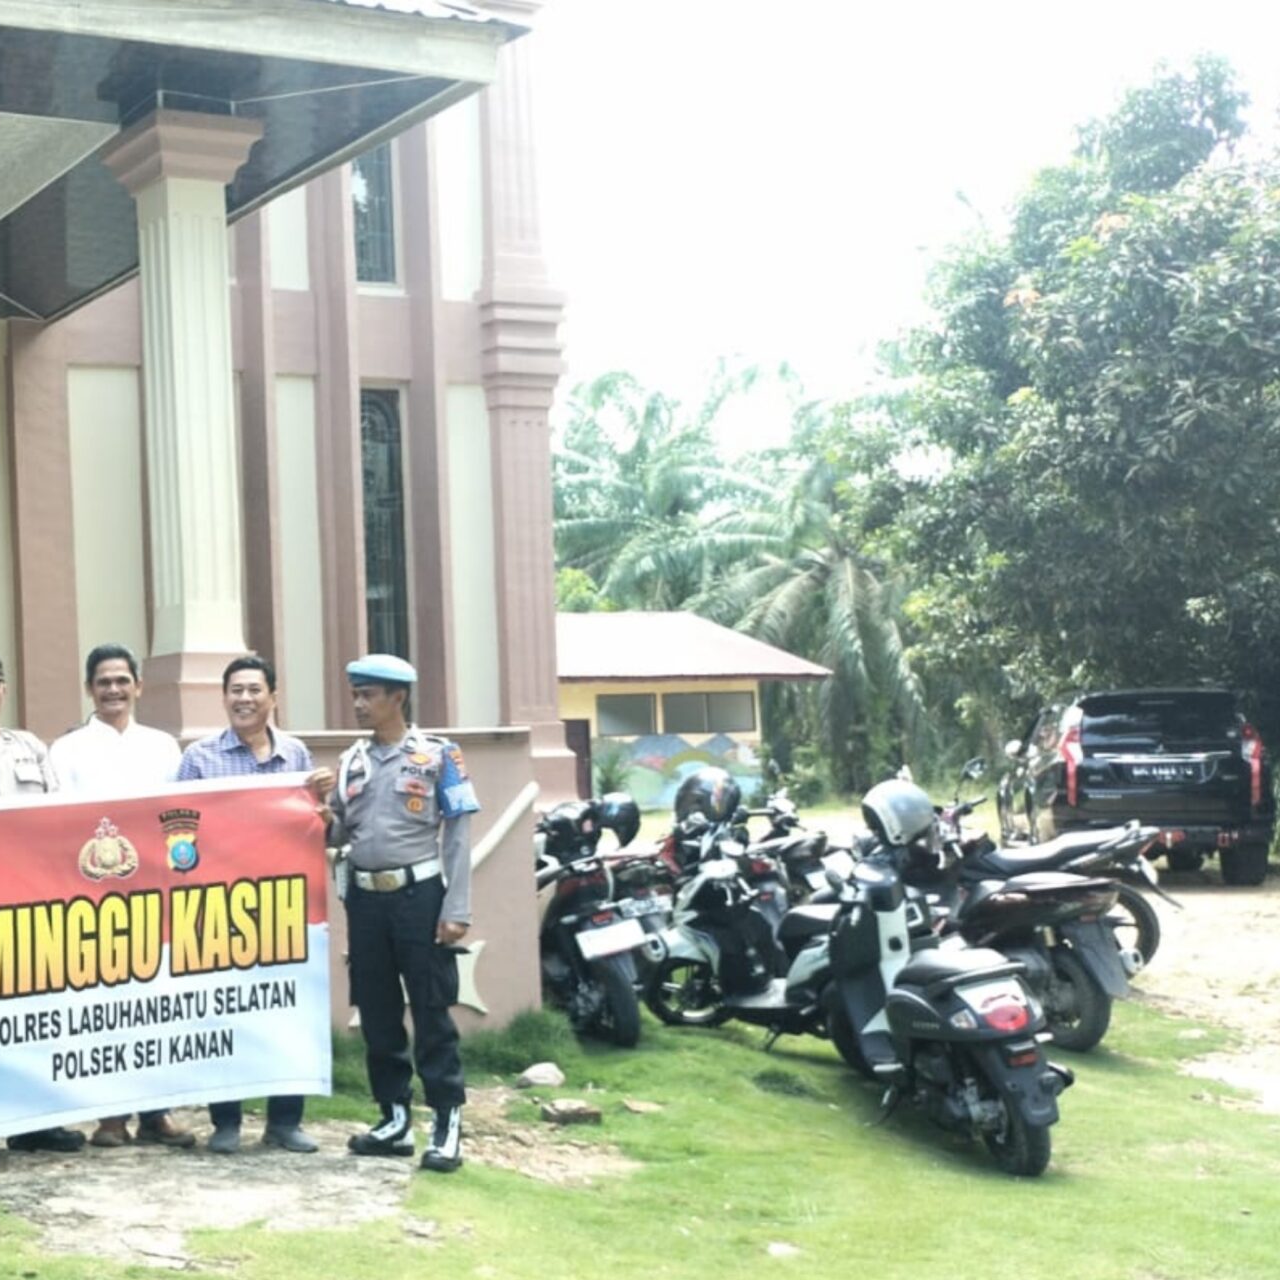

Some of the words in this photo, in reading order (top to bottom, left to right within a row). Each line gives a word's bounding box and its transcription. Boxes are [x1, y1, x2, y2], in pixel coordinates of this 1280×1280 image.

[170, 875, 308, 977] KASIH
[68, 989, 207, 1036] LABUHANBATU
[213, 980, 296, 1016] SELATAN
[52, 1044, 127, 1081] POLSEK
[133, 1038, 162, 1071] SEI
[170, 1029, 234, 1065] KANAN
